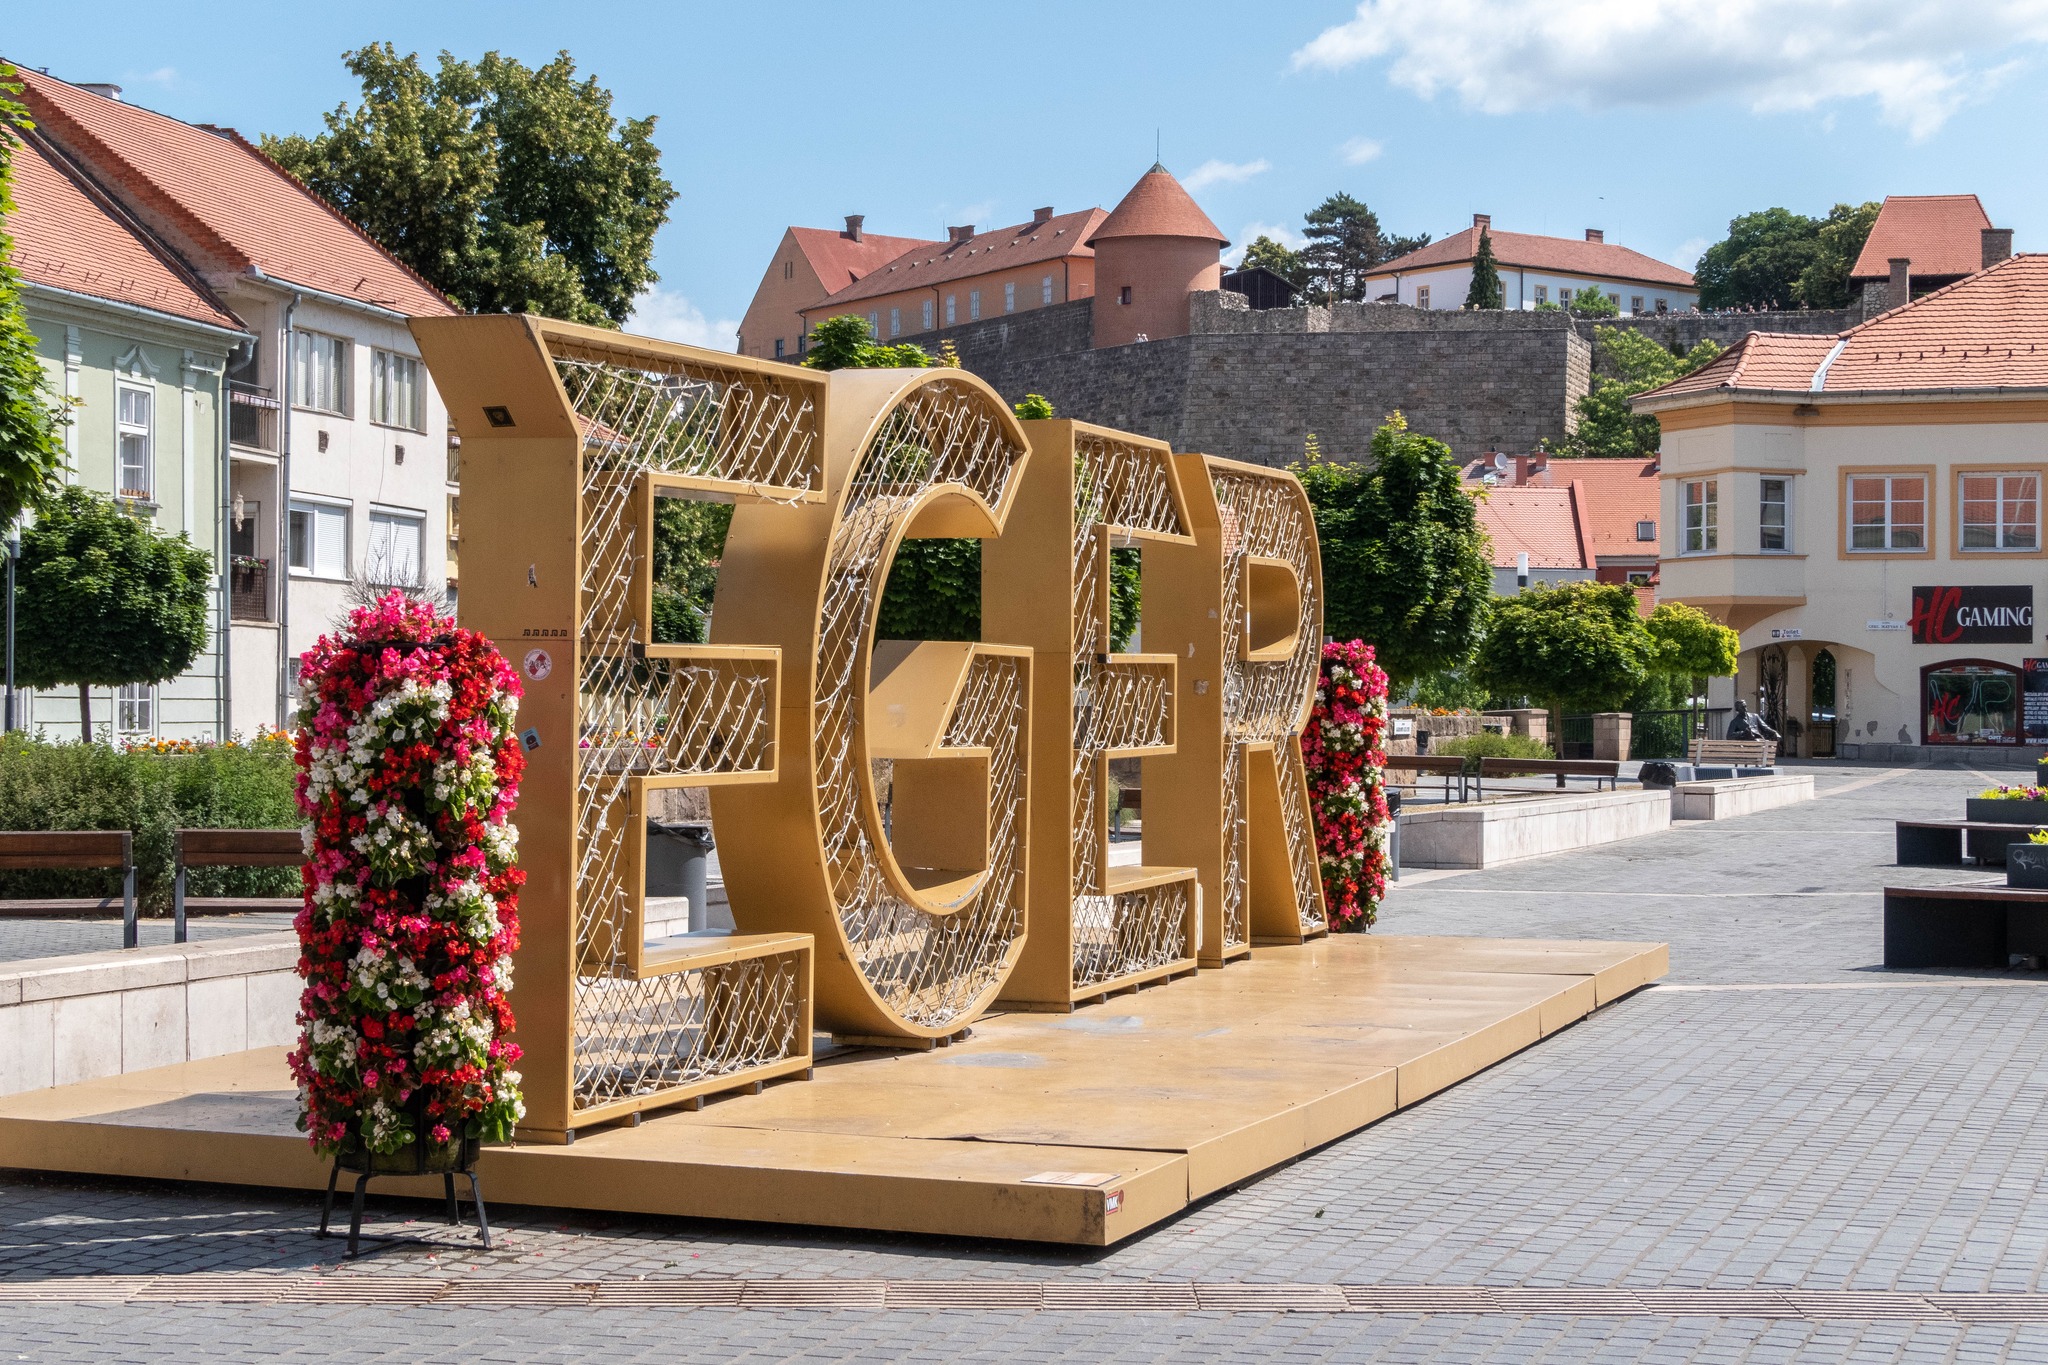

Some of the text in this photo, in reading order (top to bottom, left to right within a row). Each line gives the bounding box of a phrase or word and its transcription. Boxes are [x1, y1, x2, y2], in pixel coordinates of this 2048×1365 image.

[1907, 586, 2033, 644] HC GAMING
[410, 313, 1328, 1145] EGER
[1932, 692, 1961, 728] HC
